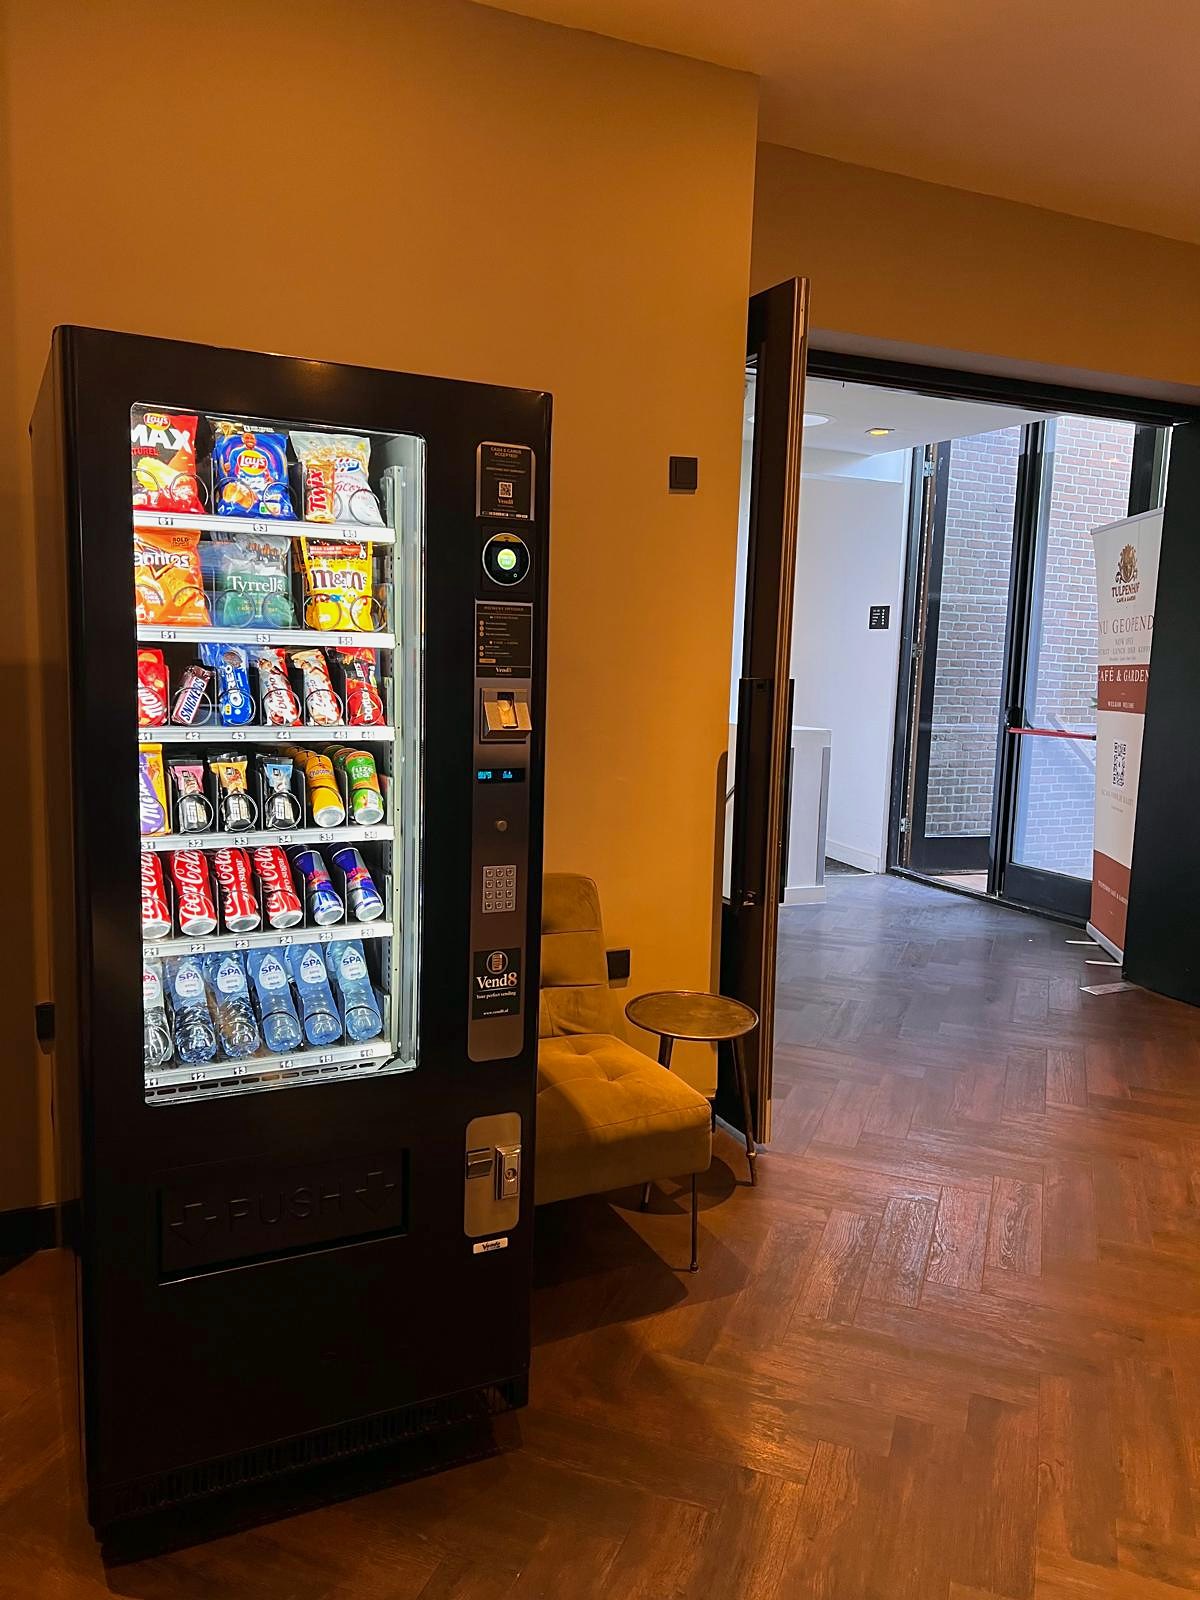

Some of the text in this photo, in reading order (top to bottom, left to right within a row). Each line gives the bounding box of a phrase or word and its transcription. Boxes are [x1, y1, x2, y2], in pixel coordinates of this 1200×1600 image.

[191, 944, 205, 952] 22
[235, 940, 250, 948] 23
[303, 959, 322, 969] SPA
[343, 955, 362, 967] SPA
[219, 966, 240, 977] SPA
[261, 964, 281, 975] SPA
[143, 973, 157, 982] PA
[178, 971, 199, 982] SPA
[476, 972, 517, 988] Vend8
[234, 1067, 247, 1075] 13
[192, 1073, 206, 1081] 12
[229, 1180, 344, 1231] PUSH
